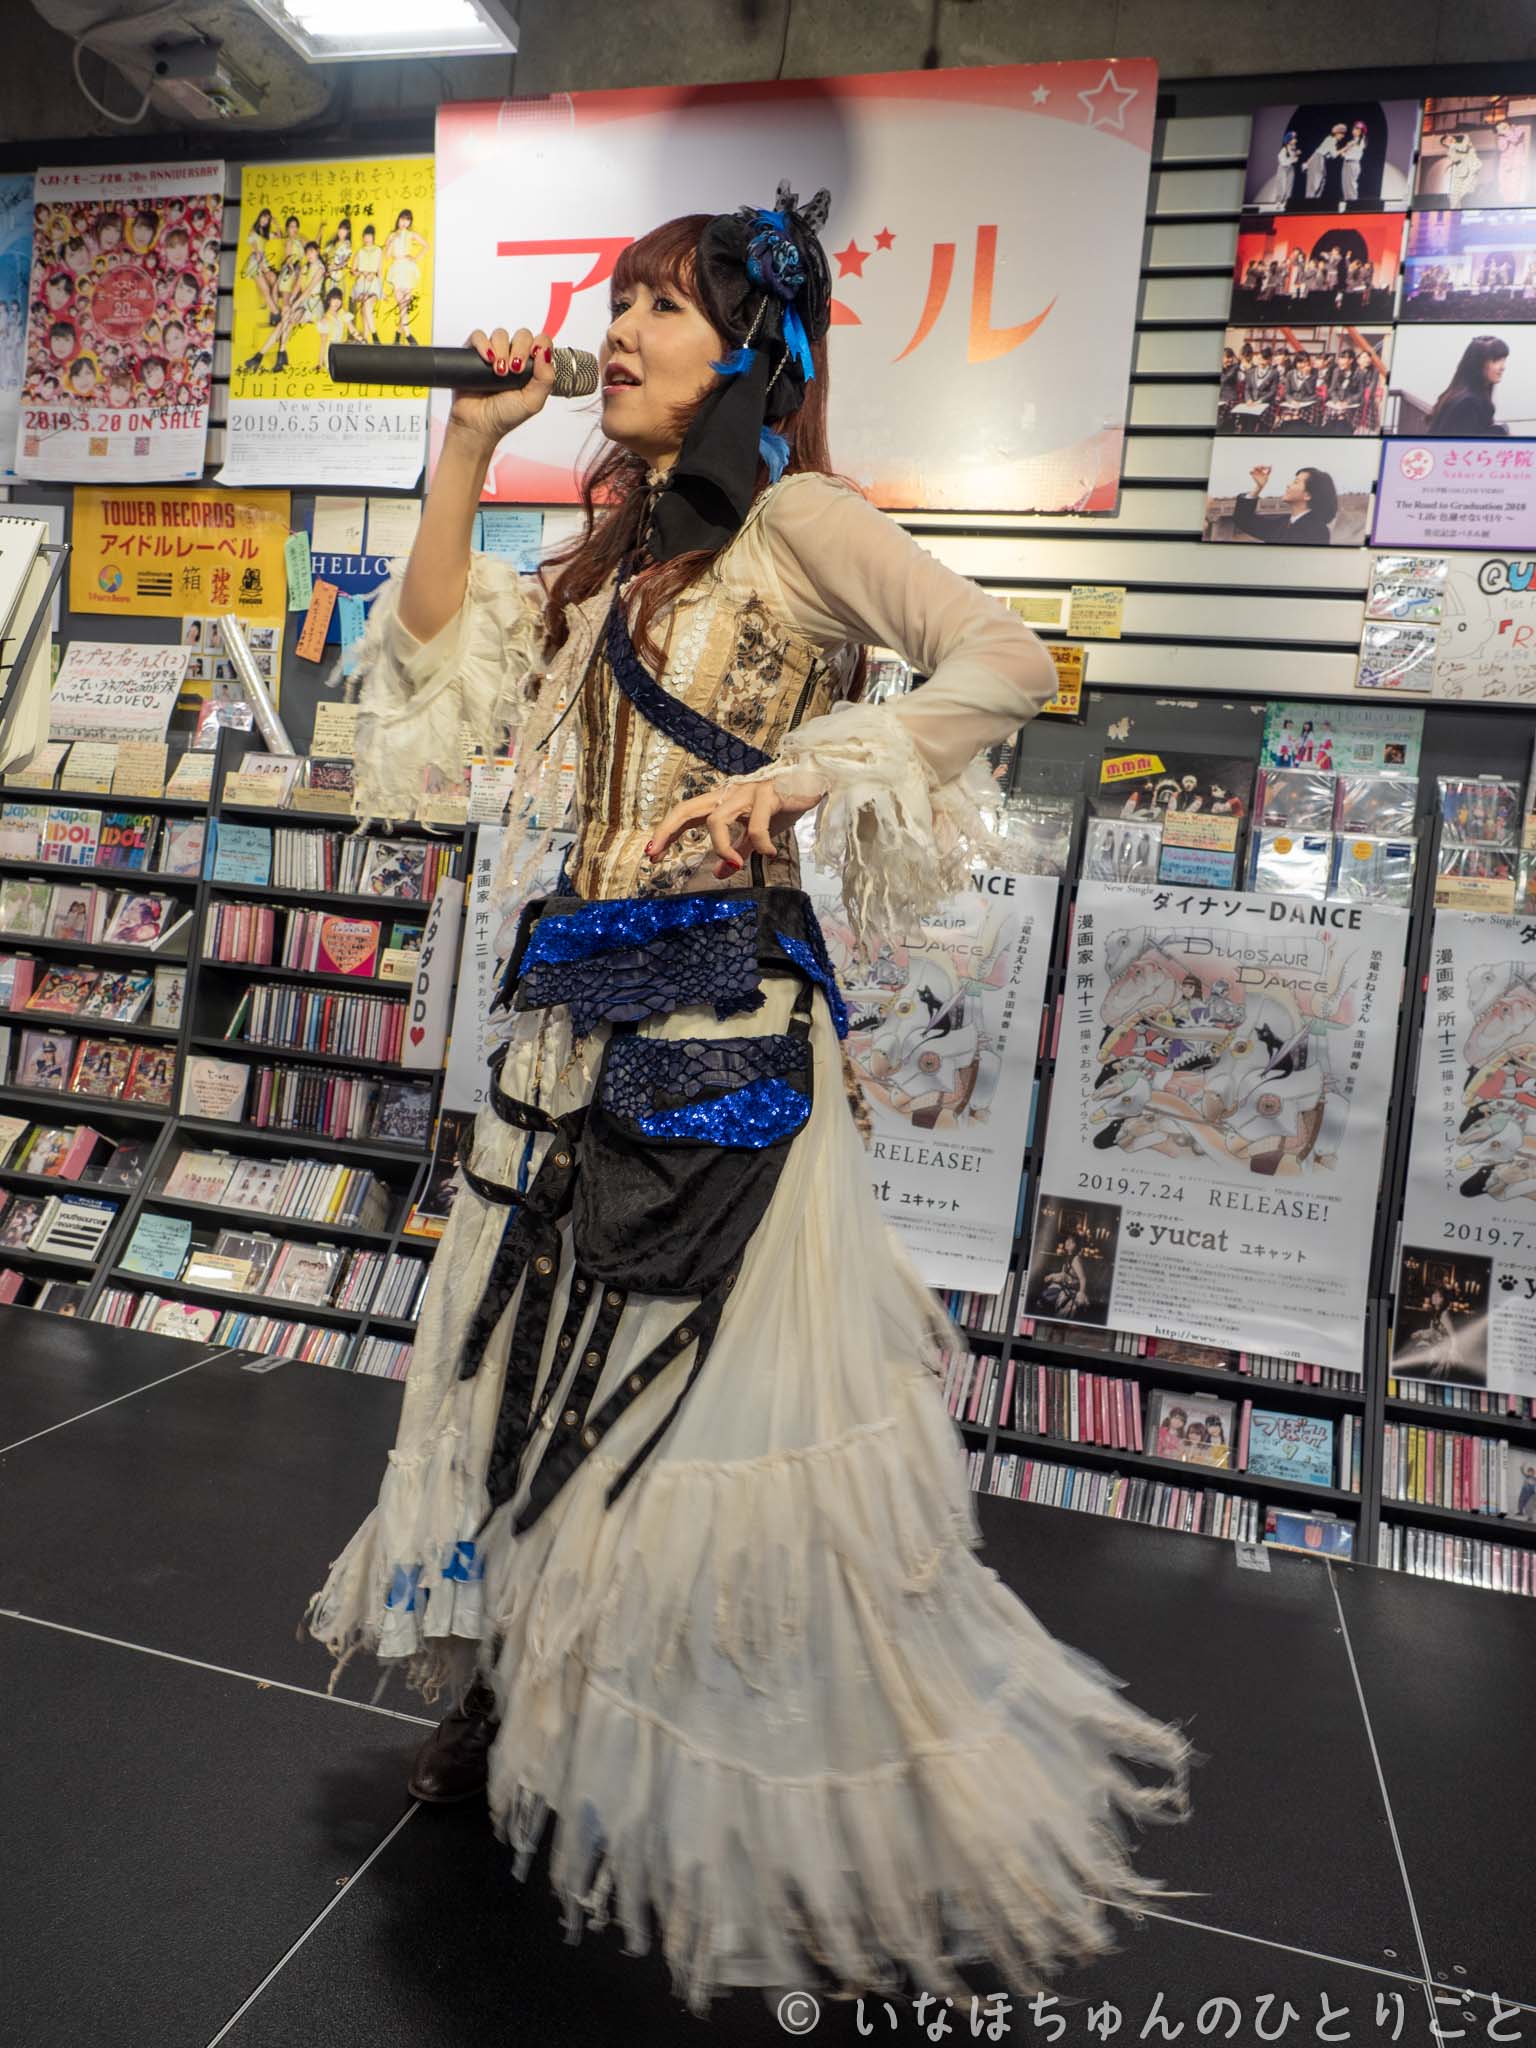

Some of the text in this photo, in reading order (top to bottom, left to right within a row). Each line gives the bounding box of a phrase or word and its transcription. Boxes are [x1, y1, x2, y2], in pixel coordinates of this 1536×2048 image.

[25, 410, 203, 432] 2019.3.20 ON SALE
[278, 401, 373, 415] New Single
[231, 415, 422, 434] 2019.6.5 ON SALE
[1443, 449, 1534, 468] さくら学院
[102, 501, 235, 529] TOWER RECORDS
[100, 534, 260, 560] アイドルレーベル
[48, 822, 97, 845] IDOL
[106, 812, 153, 828] Japan
[100, 826, 146, 849] IDOL
[43, 843, 96, 866] FILE
[477, 858, 491, 904] 漫画家
[1104, 884, 1154, 896] New Single
[1152, 892, 1363, 930] ダイナソーDANCE
[475, 911, 489, 957] 所十三
[1358, 949, 1383, 1024] 恐竜おねえさん
[1435, 948, 1455, 1001] 漫画家
[1077, 914, 1095, 1144] 漫画家 所十三 描きおろしイラスト
[1437, 1010, 1456, 1064] 所十三
[873, 1141, 983, 1173] RELEASE!
[900, 1192, 961, 1212] ユキャット
[1078, 1172, 1185, 1203] 2019.7.24
[1208, 1188, 1331, 1223] RELEASE!
[1149, 1223, 1308, 1264] yucat ユキャット
